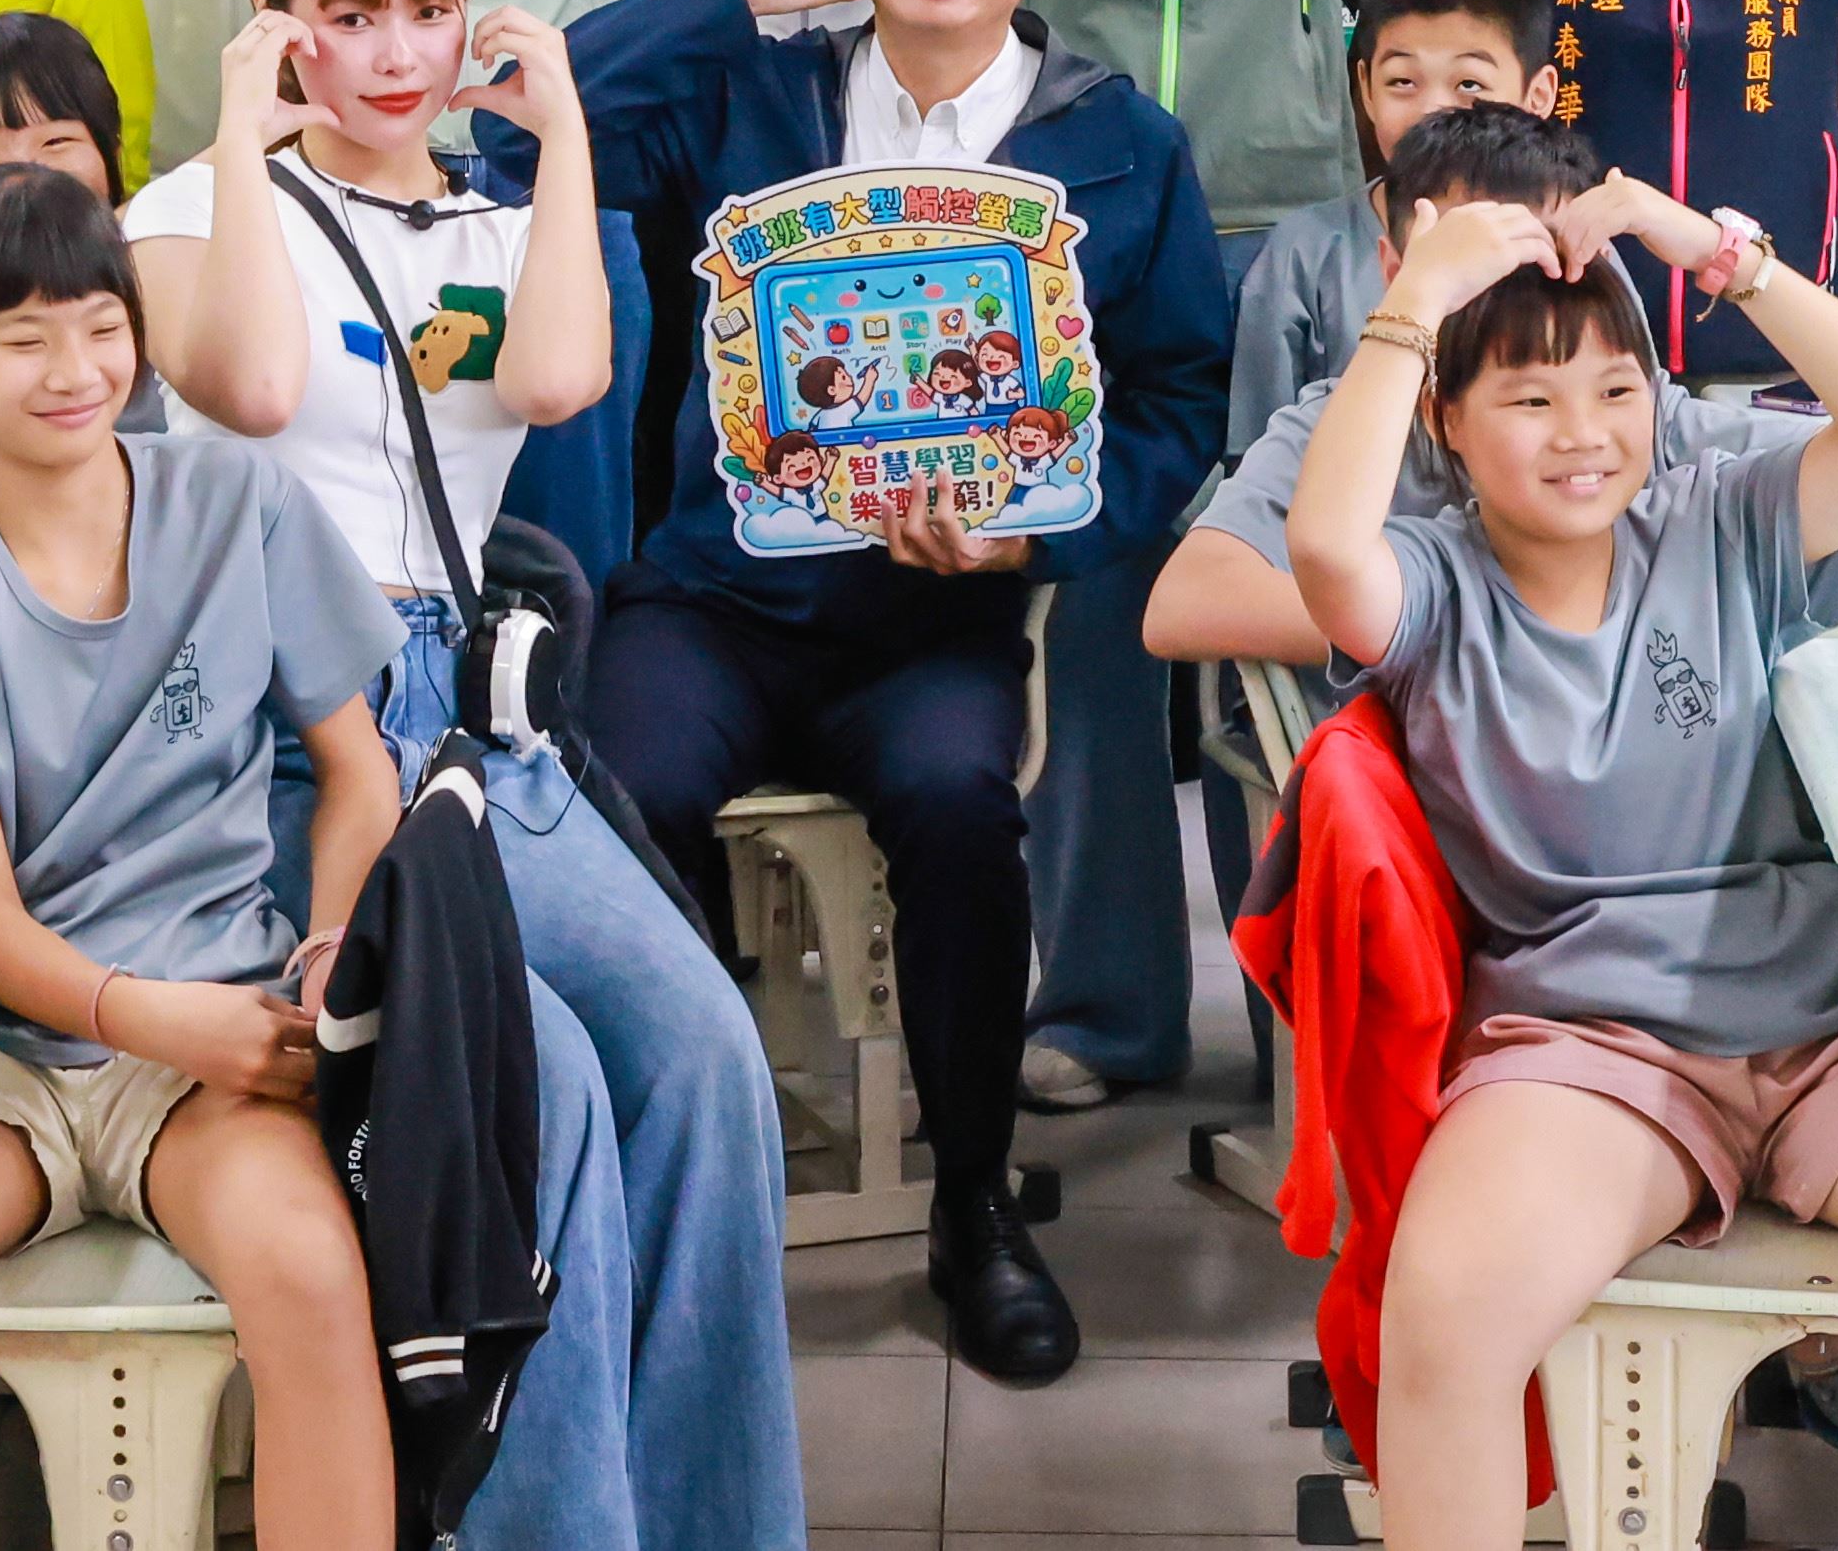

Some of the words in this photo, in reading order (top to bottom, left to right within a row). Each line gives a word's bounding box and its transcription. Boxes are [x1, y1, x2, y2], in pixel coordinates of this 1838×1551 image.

[727, 185, 1048, 268] 班班有大型觸控螢幕
[847, 444, 976, 486] 智慧學習
